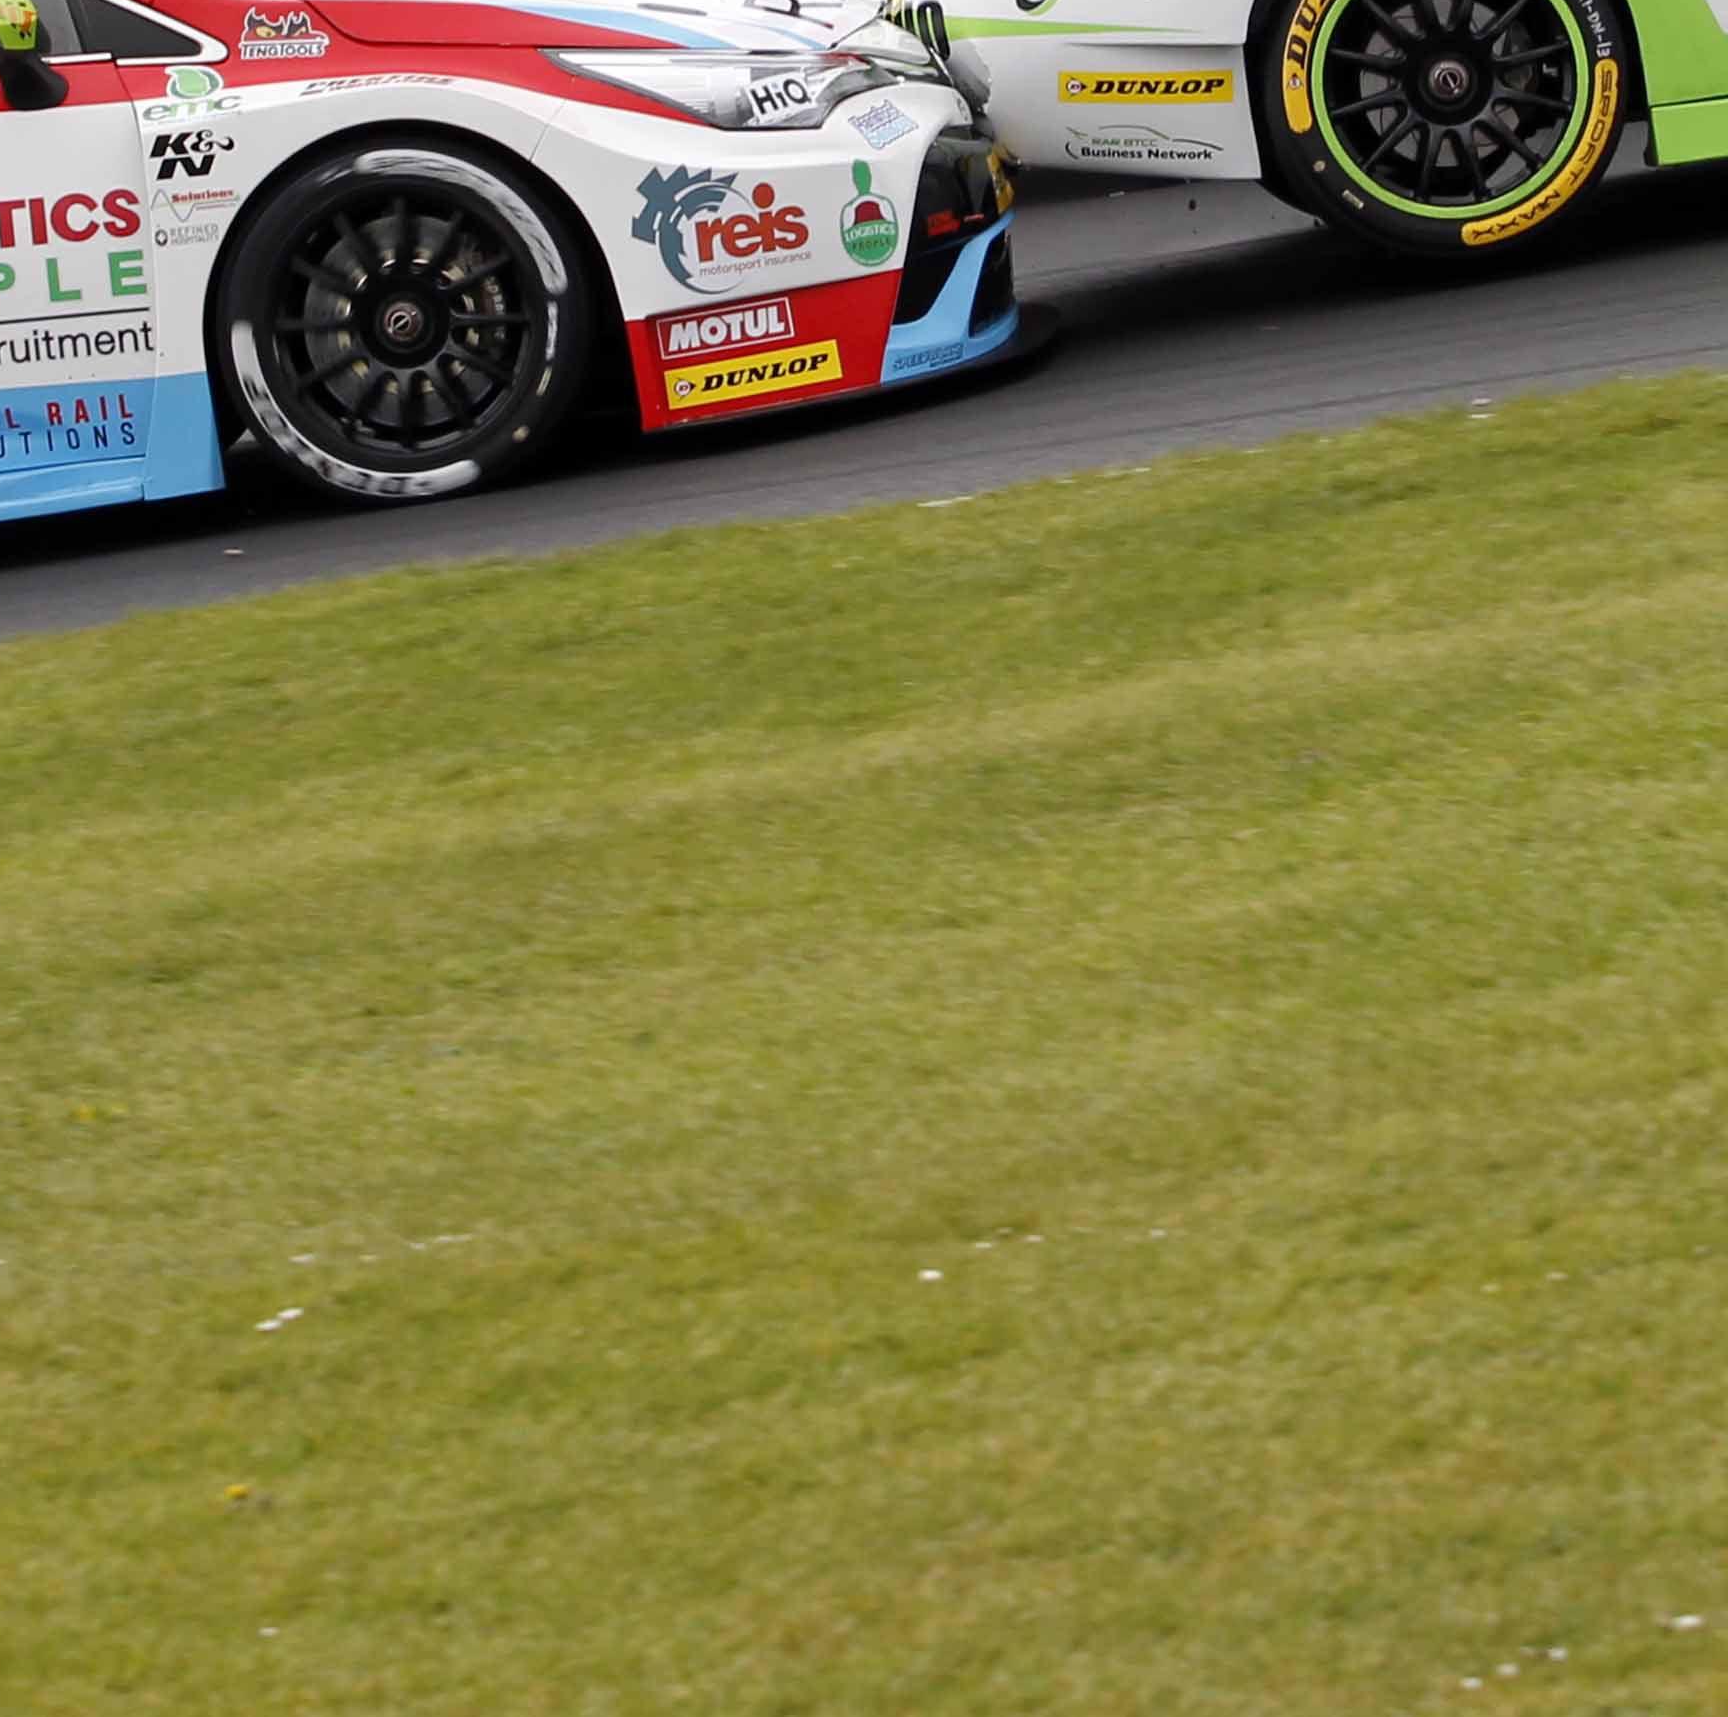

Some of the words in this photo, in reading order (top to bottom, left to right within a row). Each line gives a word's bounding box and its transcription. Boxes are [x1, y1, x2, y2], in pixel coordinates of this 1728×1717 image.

[750, 78, 812, 115] HiQ
[1092, 77, 1225, 96] DUNLOP
[143, 94, 242, 122] emc
[1568, 68, 1613, 186] SPORT
[1080, 146, 1143, 160] Business
[1148, 148, 1213, 161] Network
[171, 189, 234, 204] Solutions
[695, 182, 810, 264] reis
[699, 258, 762, 277] motorsport
[763, 250, 812, 269] insurance
[668, 305, 786, 353] MOTUL
[701, 352, 830, 393] DUNLOP
[47, 393, 135, 426] RAIL
